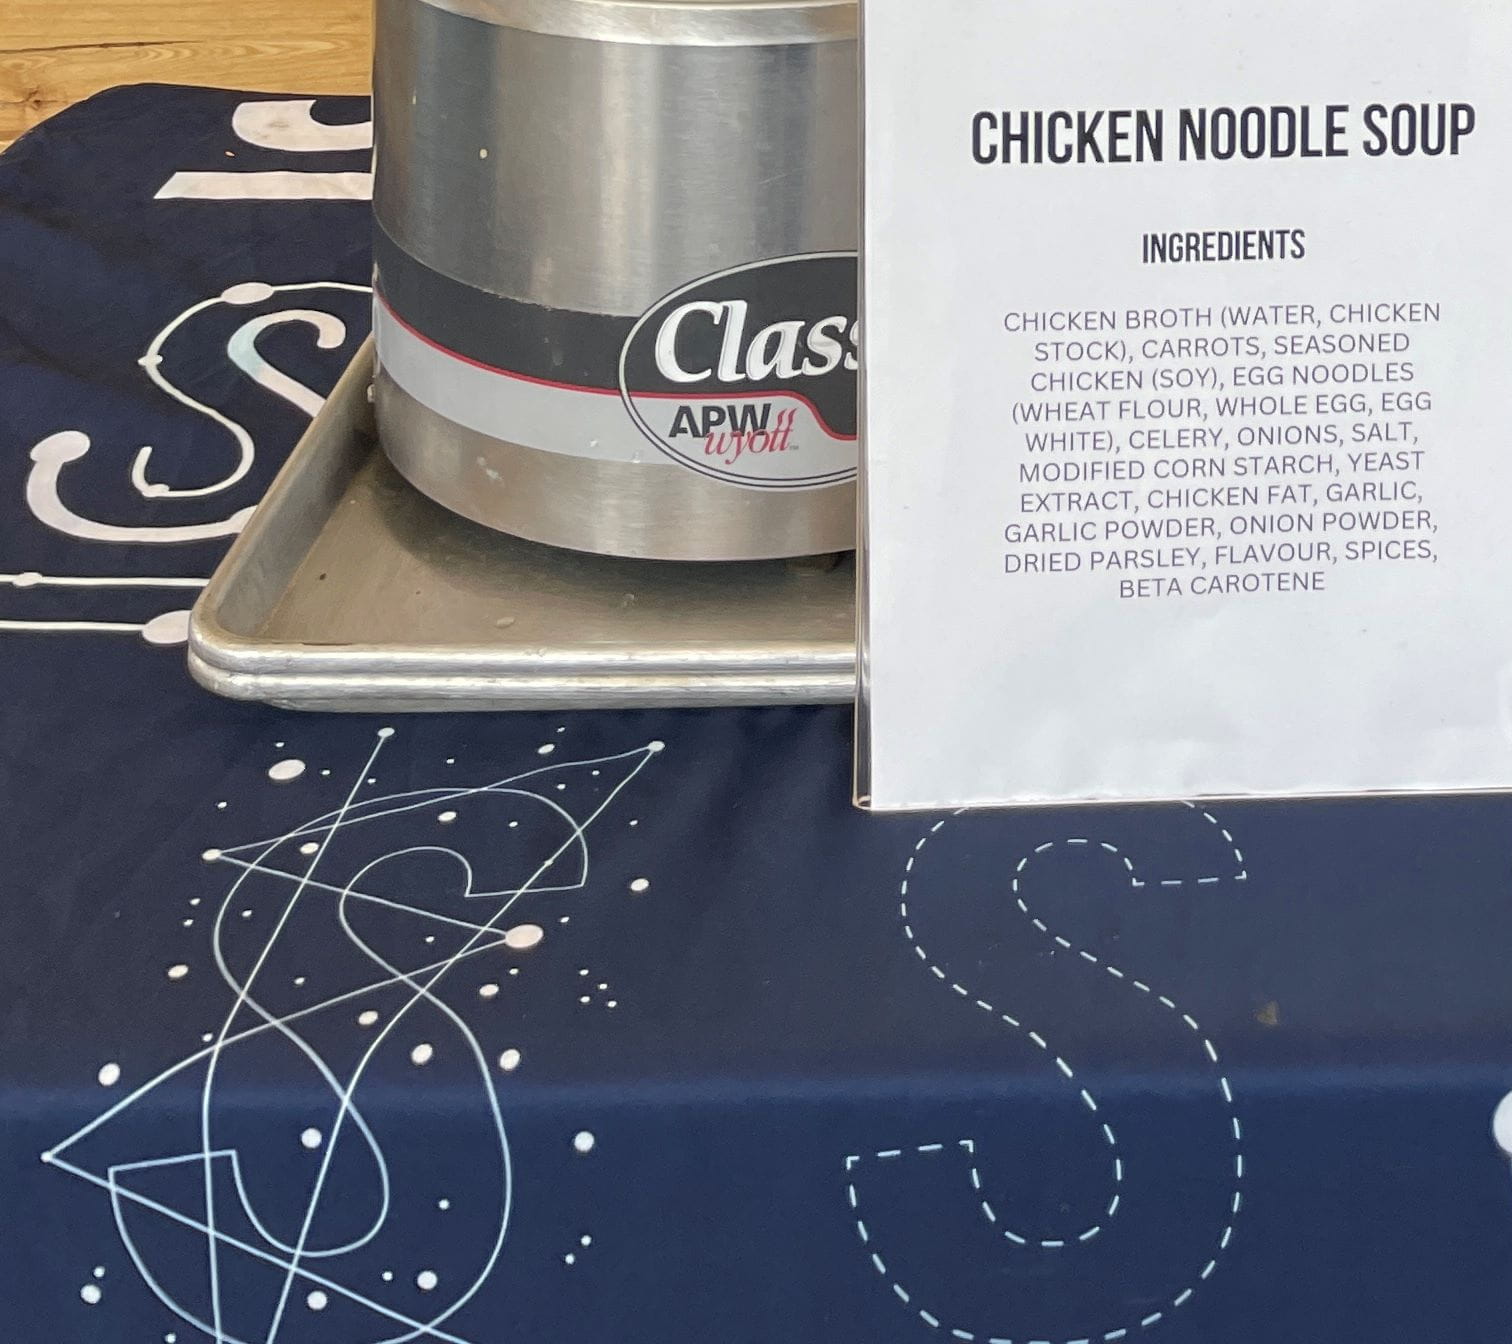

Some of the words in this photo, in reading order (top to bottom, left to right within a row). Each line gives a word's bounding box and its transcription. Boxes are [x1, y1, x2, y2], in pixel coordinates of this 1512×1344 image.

[972, 110, 1163, 164] CHICKEN
[1179, 105, 1349, 161] NOODLE
[1363, 103, 1475, 156] SOUP
[1143, 229, 1305, 263] INGREDIENTS
[1003, 310, 1116, 333] CHICKEN
[1125, 306, 1212, 330] BROTH
[1220, 304, 1322, 329] (WATER,
[1329, 302, 1440, 324] CHICKEN
[1034, 339, 1134, 365] STOCK),
[1141, 335, 1267, 360] CARROTS,
[1274, 332, 1410, 356] SEASONED
[1030, 369, 1143, 392] CHICKEN
[1151, 366, 1225, 392] (SOY),
[1233, 365, 1284, 387] EGG
[1292, 361, 1415, 386] NOODLES
[667, 402, 772, 439] APW
[1012, 400, 1112, 426] (WHEAT
[1118, 397, 1208, 423] FLOUR,
[1215, 394, 1308, 417] WHOLE
[1315, 392, 1373, 417] EGG,
[1381, 391, 1432, 412] EGG
[1019, 459, 1146, 483] MODIFIED
[1153, 457, 1225, 479] CORN
[1233, 453, 1340, 478] STARCH,
[1347, 450, 1426, 473] YEAST
[1020, 490, 1140, 515] EXTRACT,
[1147, 485, 1259, 510] CHICKEN
[1267, 483, 1318, 508] FAT,
[1325, 480, 1423, 504] GARLIC,
[1004, 521, 1097, 544] GARLIC
[1105, 516, 1222, 541] POWDER,
[1229, 512, 1314, 535] ONION
[1322, 509, 1438, 534] POWDER,
[1004, 551, 1082, 574] DRIED
[1090, 546, 1207, 572] PARSLEY,
[1215, 541, 1338, 566] FLAVOUR,
[1344, 539, 1438, 564] SPICES,
[1119, 577, 1183, 599] BETA
[1190, 570, 1326, 596] CAROTENE
